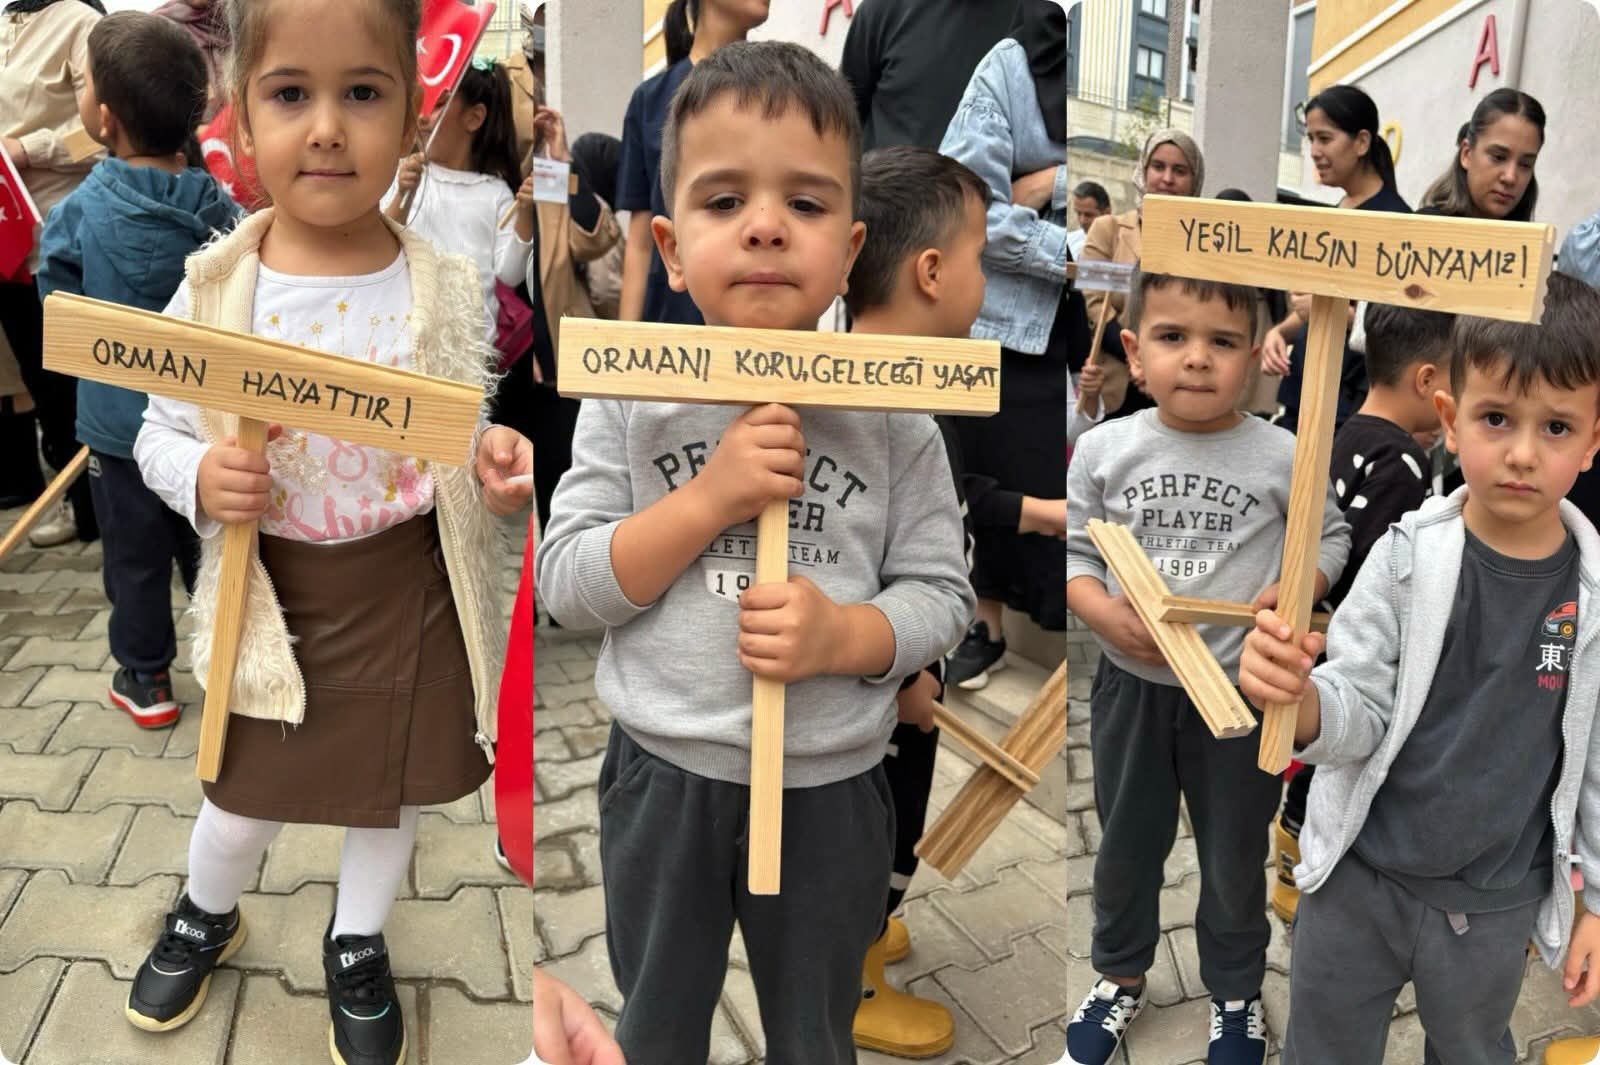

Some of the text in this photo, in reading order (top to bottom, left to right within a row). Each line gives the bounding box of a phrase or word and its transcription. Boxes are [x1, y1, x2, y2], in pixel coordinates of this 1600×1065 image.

[1468, 14, 1500, 90] A
[1180, 218, 1253, 253] YEŞİL
[1267, 225, 1357, 269] KALSIN
[92, 338, 207, 387] ORMAN
[582, 347, 711, 382] ORMANI
[1122, 473, 1260, 517] PERFECT
[1142, 508, 1233, 532] PLAYER
[789, 545, 841, 565] TEAM
[1136, 535, 1198, 550] THLETIC
[1159, 559, 1208, 577] 1988
[1536, 643, 1575, 672] 東
